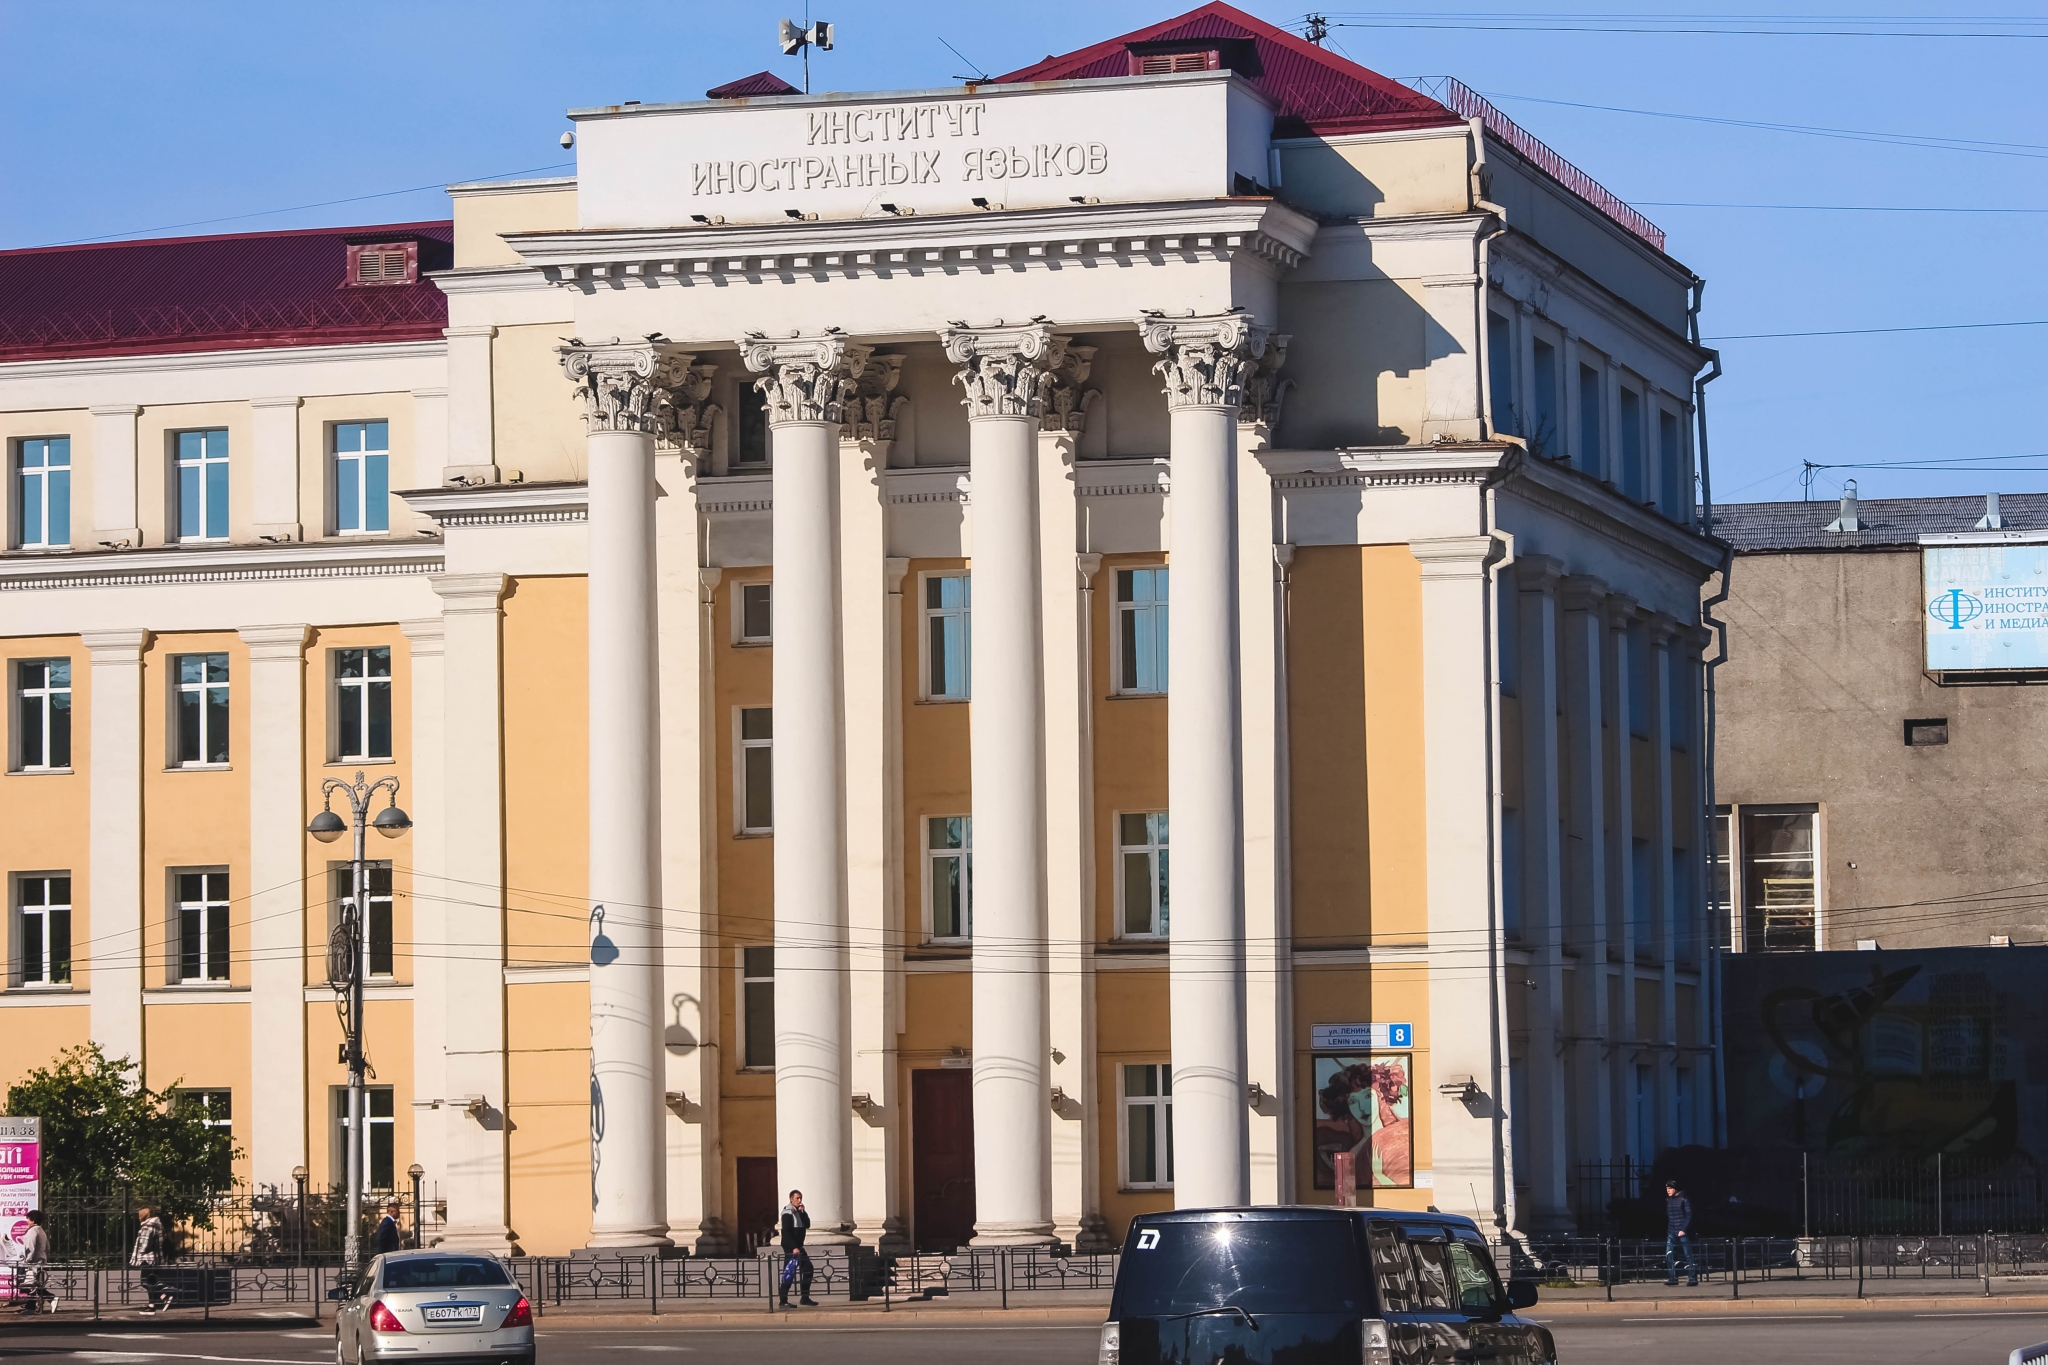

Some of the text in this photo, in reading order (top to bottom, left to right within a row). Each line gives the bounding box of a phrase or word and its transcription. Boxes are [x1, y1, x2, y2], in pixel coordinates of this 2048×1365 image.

[806, 102, 986, 145] ИНСТИТУТ
[690, 141, 1108, 196] ИНОСТРАННЫХ ЯЗЫКОВ
[1941, 555, 1988, 565] CANADA
[1929, 565, 1992, 581] CANADA
[1985, 619, 1995, 629] И
[1341, 1027, 1371, 1035] ЛЕНИНА
[1395, 1028, 1405, 1042] 8
[19, 1126, 35, 1136] 38
